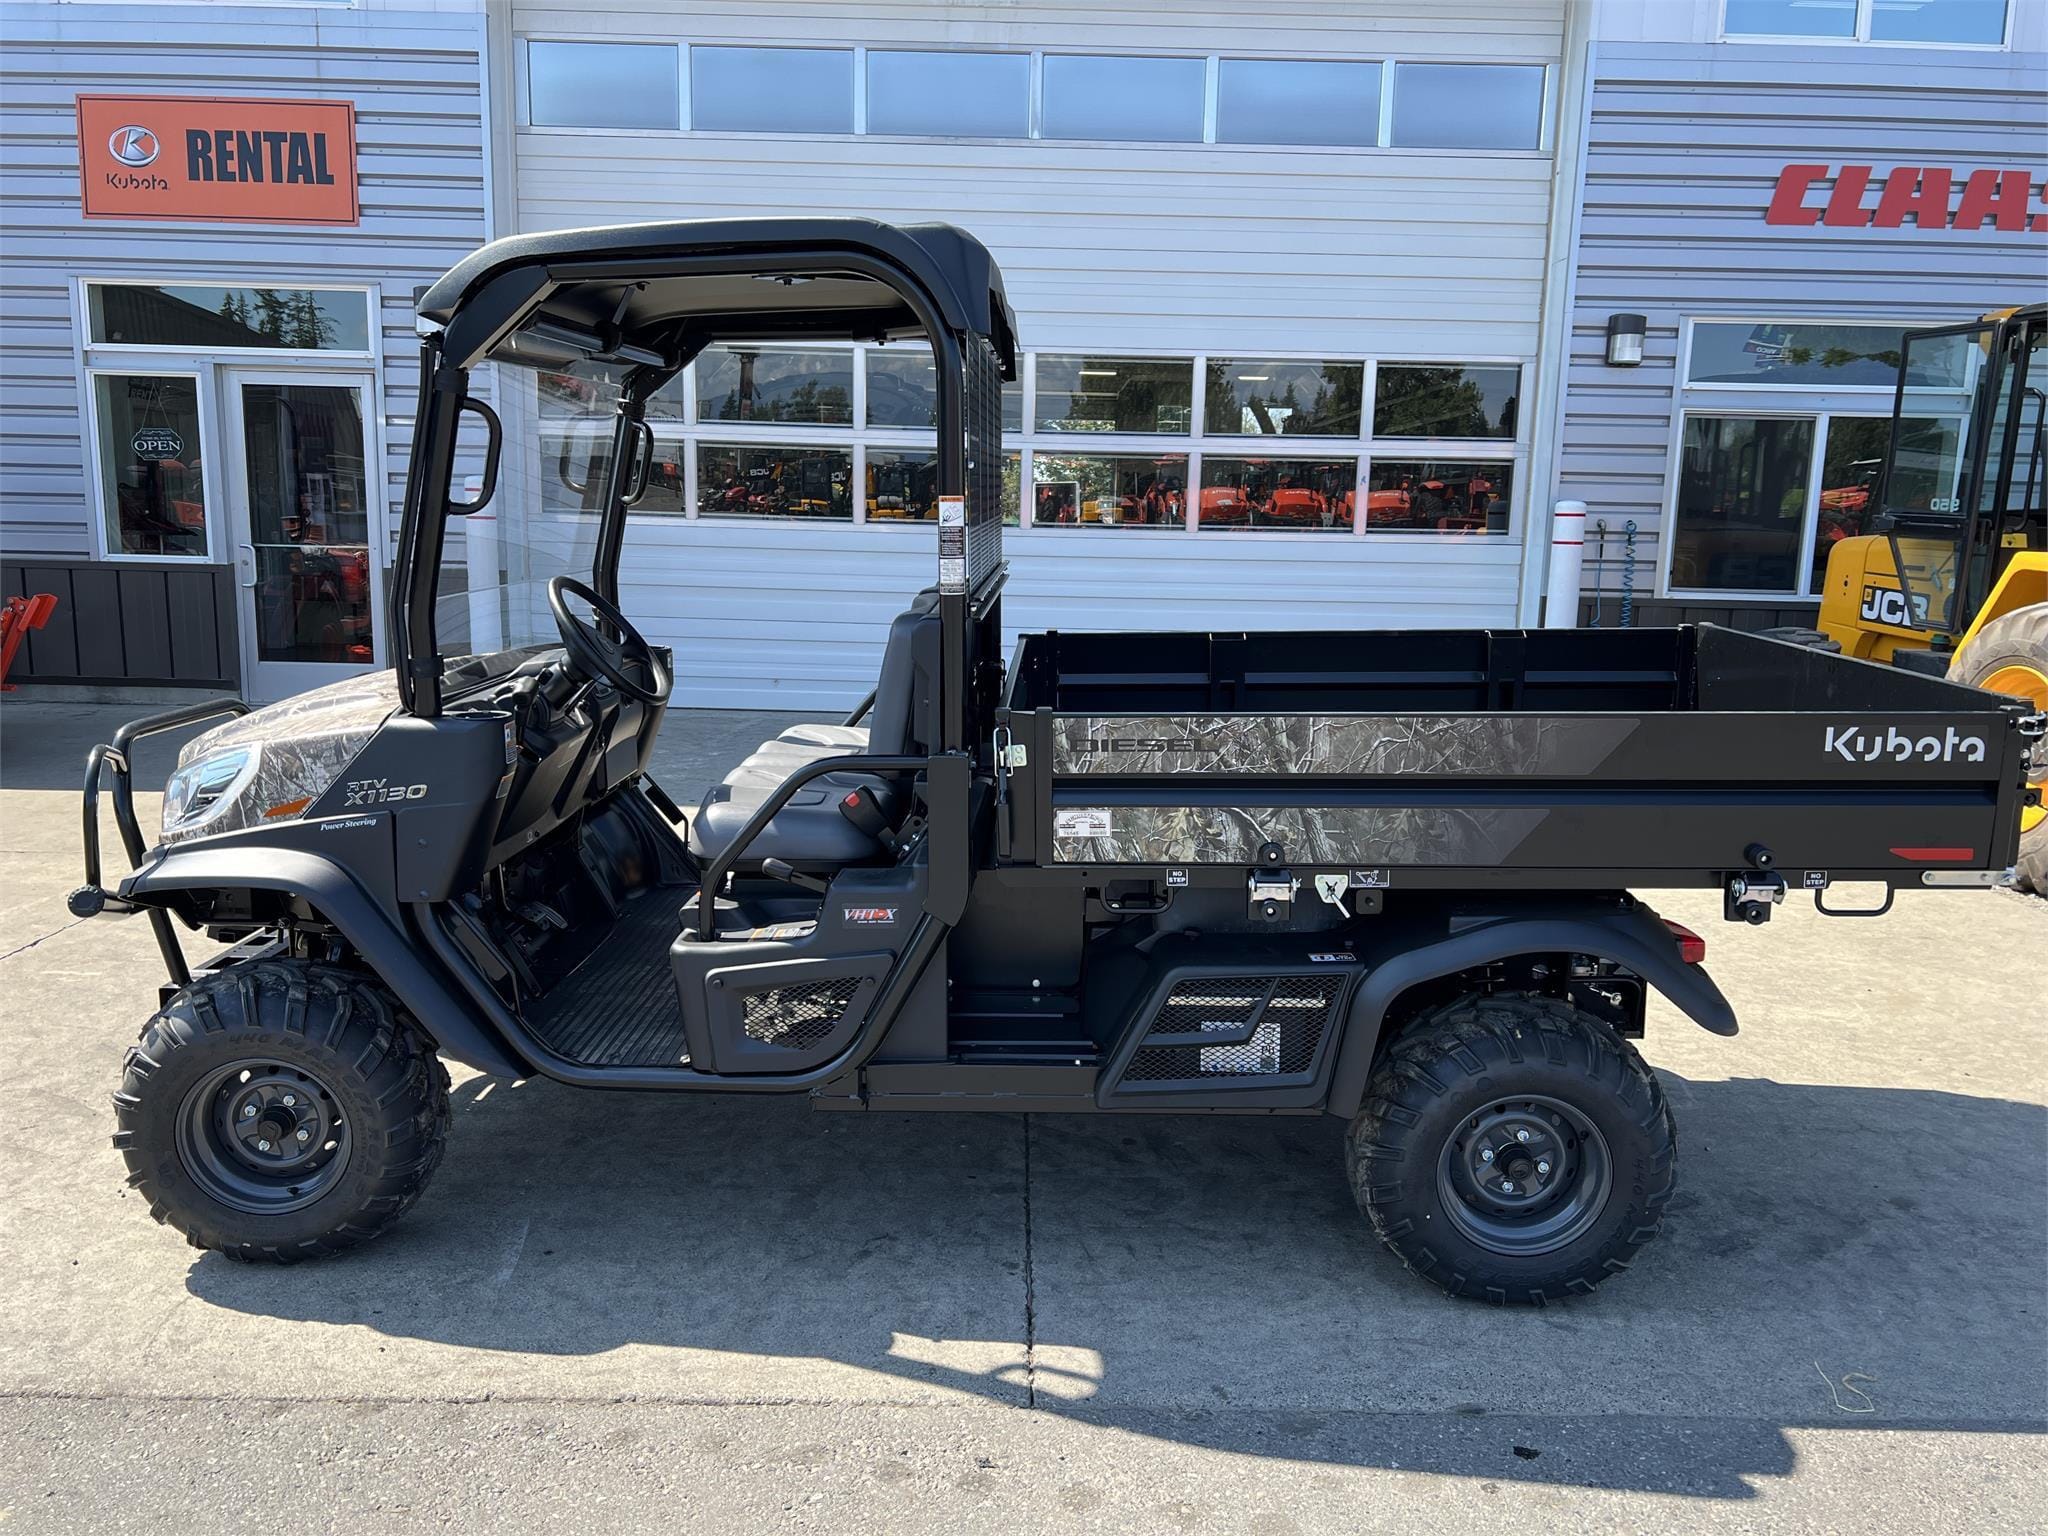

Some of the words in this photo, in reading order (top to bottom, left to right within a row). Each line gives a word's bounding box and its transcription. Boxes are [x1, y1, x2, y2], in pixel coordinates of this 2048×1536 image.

[185, 128, 335, 185] RENTAL
[106, 172, 169, 191] Kubota
[134, 440, 181, 451] OPEN
[1070, 738, 1220, 752] DIESEL
[1824, 726, 1986, 762] Kubota
[346, 778, 387, 792] RTV
[344, 784, 428, 806] X1130
[320, 821, 344, 831] Power
[344, 818, 377, 828] Steering
